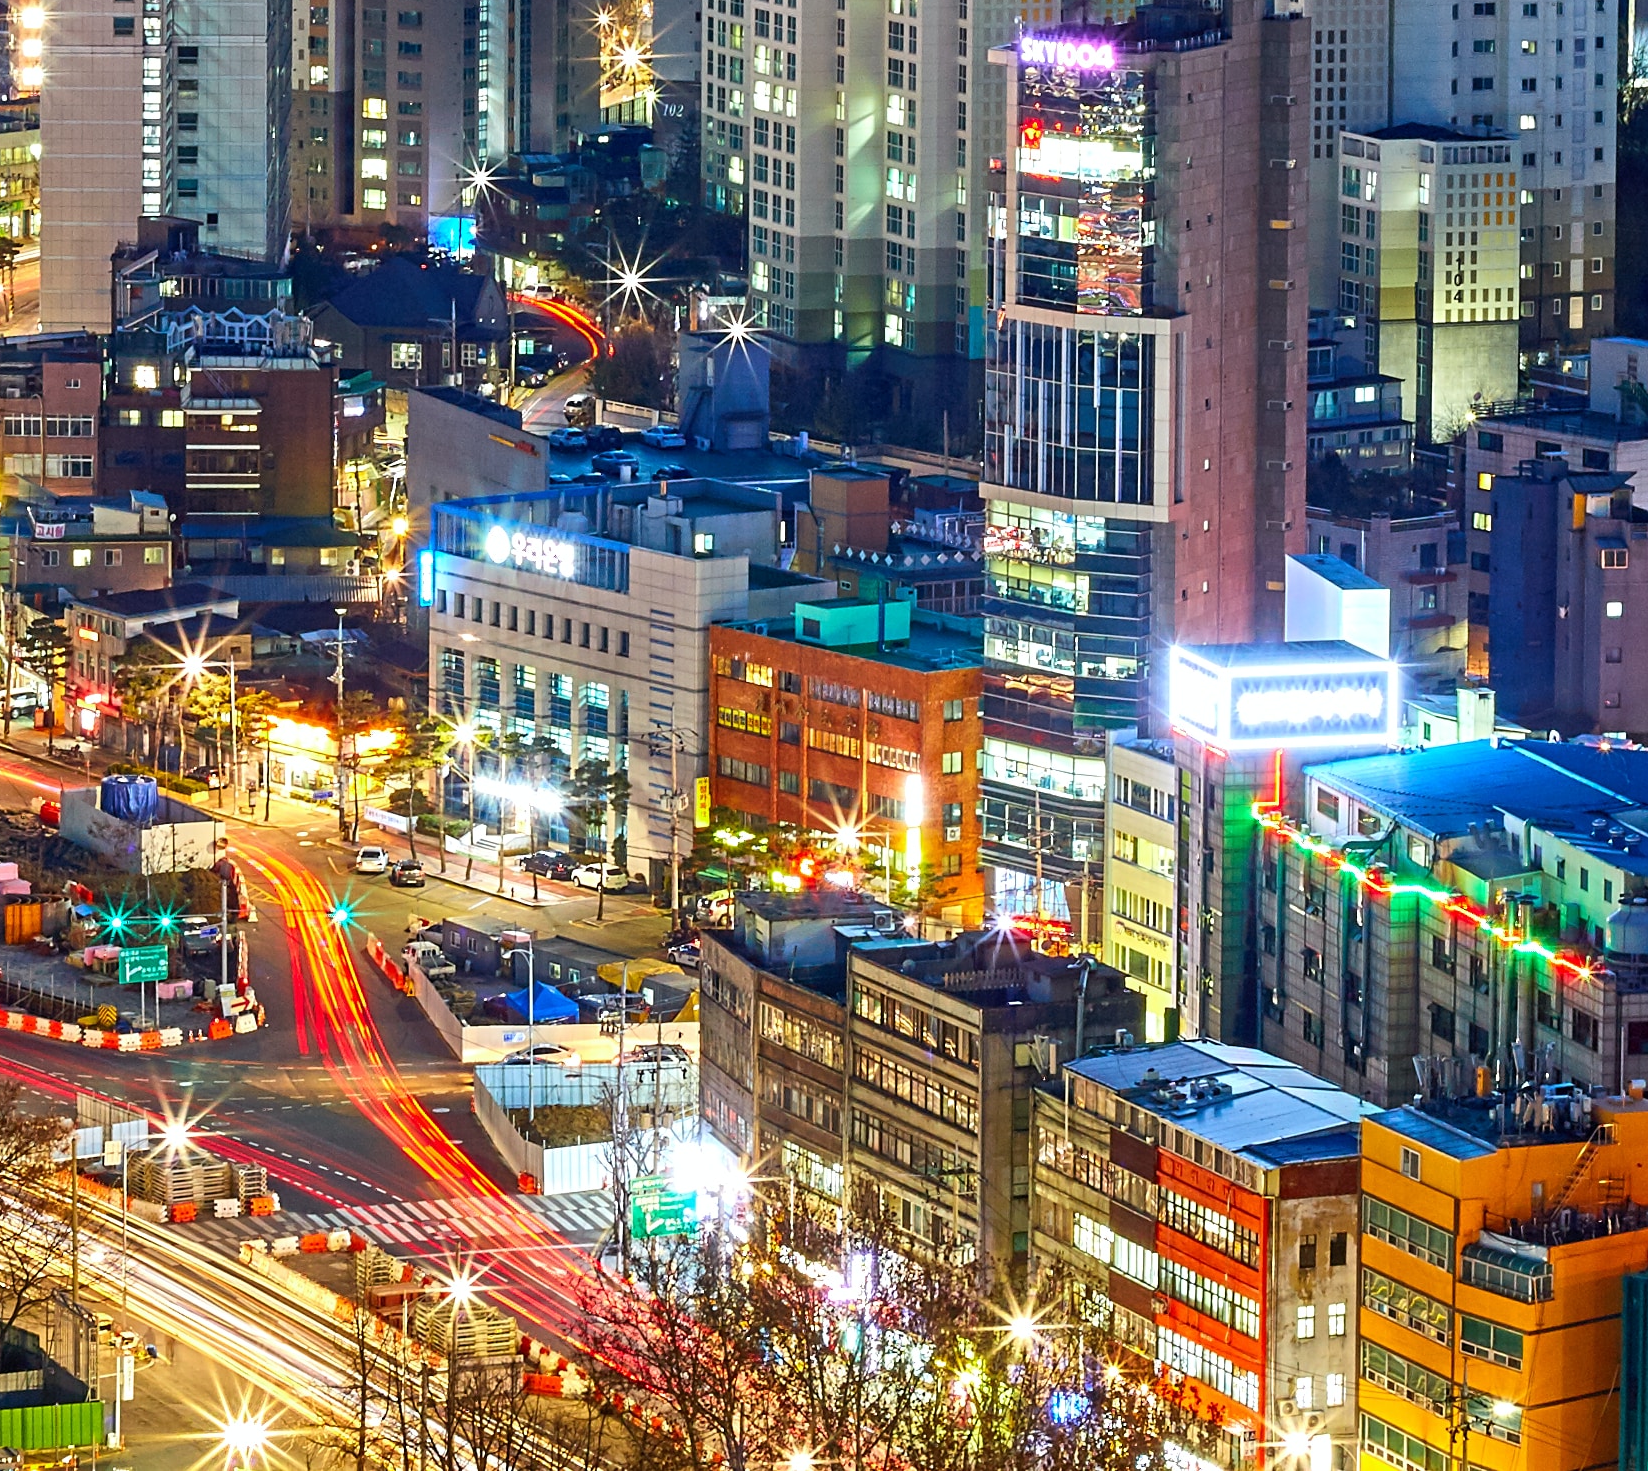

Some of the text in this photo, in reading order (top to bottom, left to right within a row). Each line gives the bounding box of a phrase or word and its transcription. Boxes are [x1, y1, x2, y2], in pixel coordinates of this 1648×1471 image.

[1021, 37, 1116, 69] SKY1004
[663, 104, 684, 117] 102
[1453, 257, 1462, 303] 104
